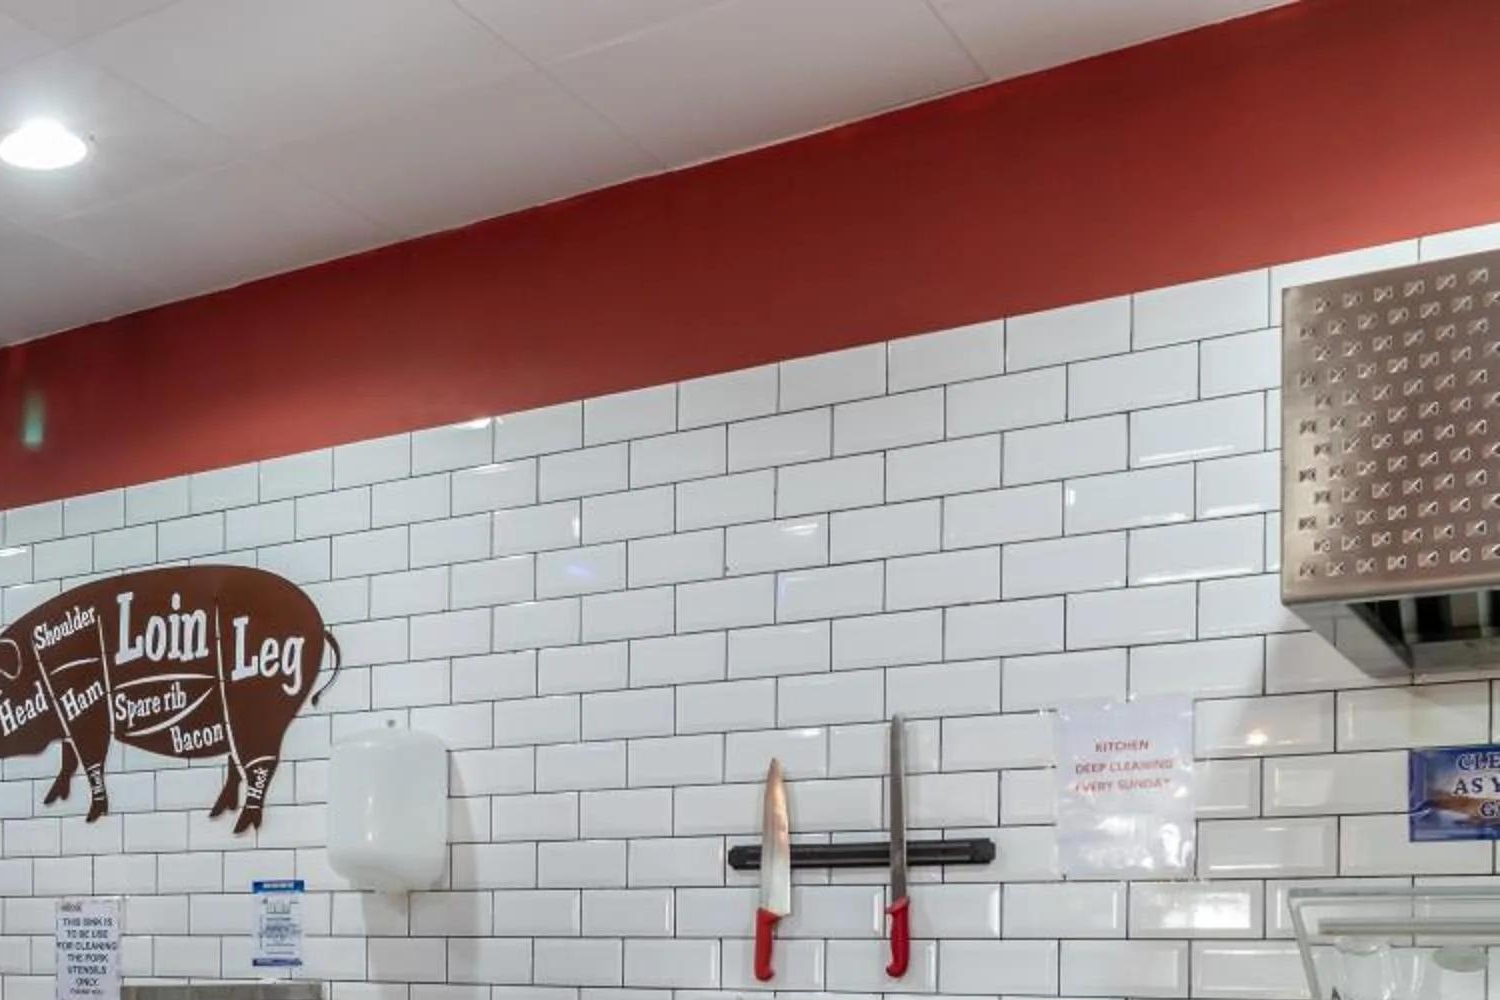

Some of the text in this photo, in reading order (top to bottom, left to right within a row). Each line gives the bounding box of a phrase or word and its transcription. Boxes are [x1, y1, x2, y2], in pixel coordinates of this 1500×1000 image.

[33, 604, 96, 652] Shoulder
[115, 591, 209, 666] Loin
[231, 615, 305, 696] Leg
[60, 680, 104, 721] Ham
[115, 682, 187, 729] Spare rib
[170, 722, 225, 754] Bacon
[1095, 740, 1149, 752] KITCHEN
[1075, 759, 1173, 774] DEEP CLEANING
[247, 767, 269, 800] Hock
[1453, 777, 1484, 795] AS
[1479, 801, 1500, 818] G
[63, 917, 113, 927] THIS SINK IS
[66, 929, 77, 939] TO
[79, 929, 90, 939] BE
[56, 941, 118, 951] FOR CLEANING
[67, 953, 109, 963] THE PORK
[67, 965, 107, 975] UTENSILS
